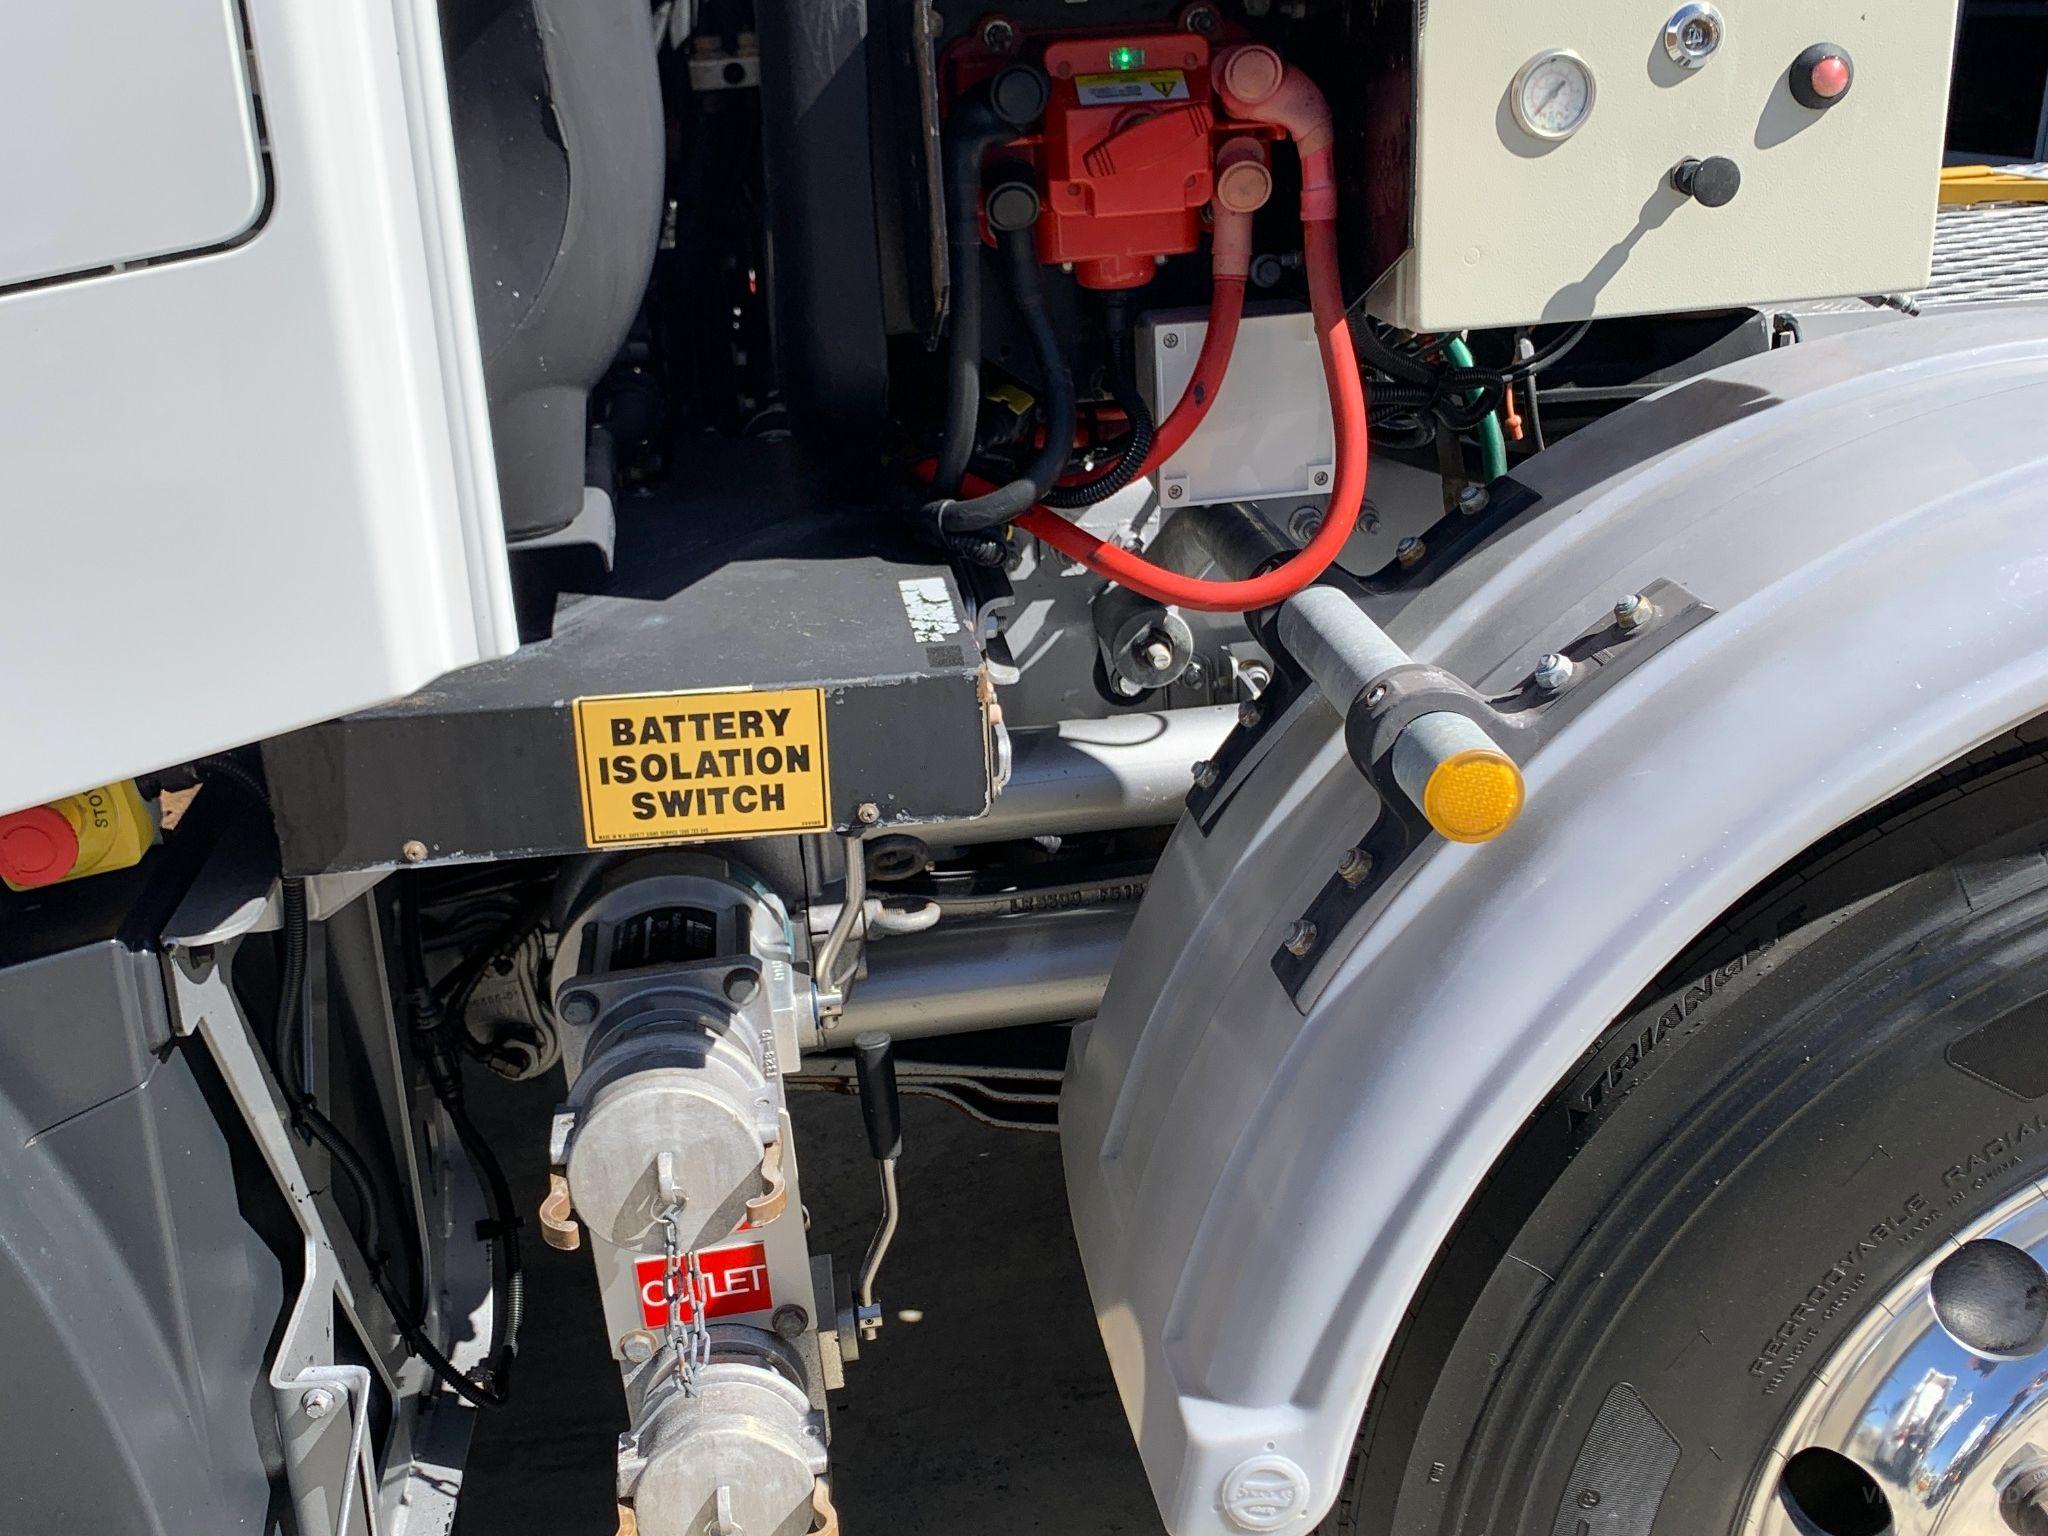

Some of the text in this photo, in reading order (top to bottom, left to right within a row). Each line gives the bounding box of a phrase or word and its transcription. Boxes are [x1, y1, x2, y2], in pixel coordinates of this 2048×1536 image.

[610, 708, 791, 746] BATTERY
[599, 744, 810, 785] ISOLATION
[83, 788, 109, 829] STO
[632, 783, 785, 820] SWITCH
[641, 1264, 766, 1307] OLET
